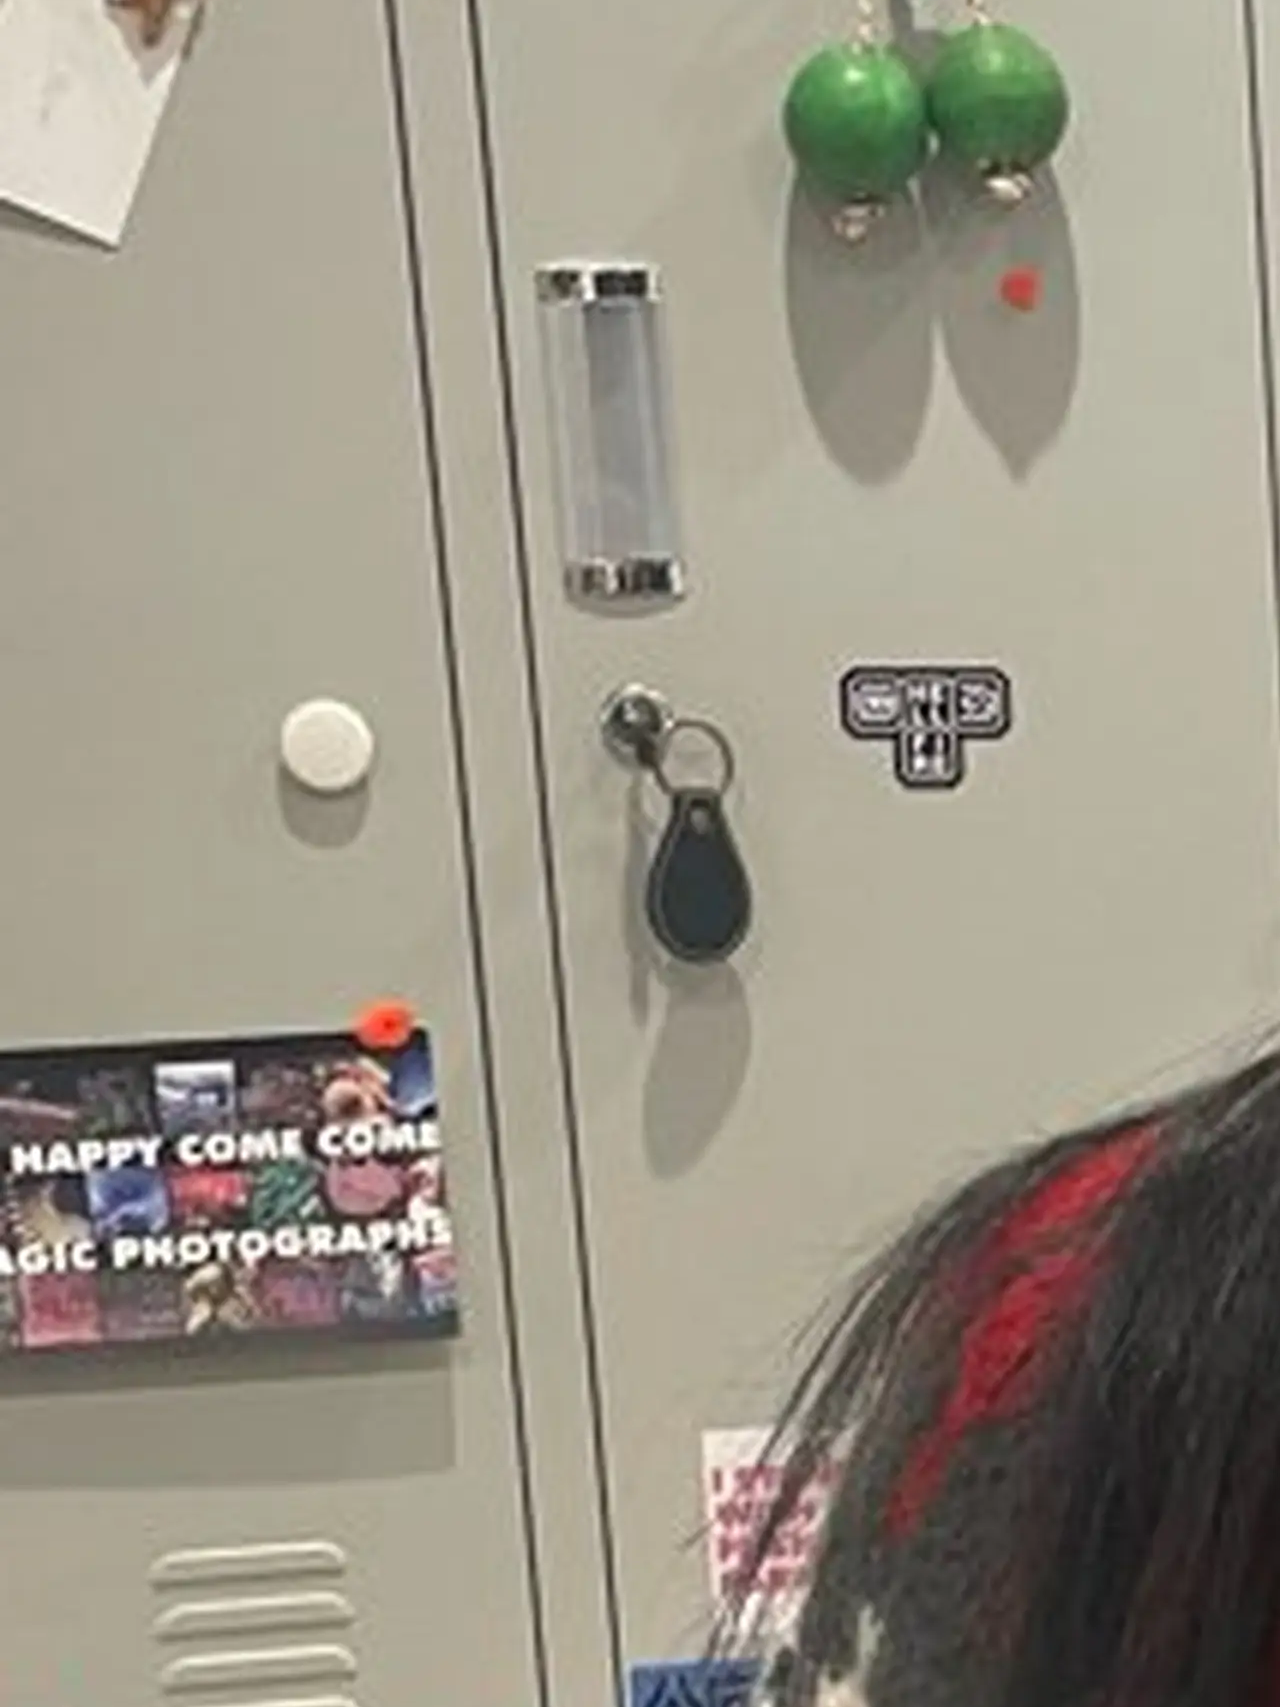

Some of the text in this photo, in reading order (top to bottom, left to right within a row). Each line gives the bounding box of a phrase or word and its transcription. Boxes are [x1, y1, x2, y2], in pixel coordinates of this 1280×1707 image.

[11, 1120, 442, 1175] HAPPY COME COME
[112, 1215, 453, 1271] PHOTOGRAPHS
